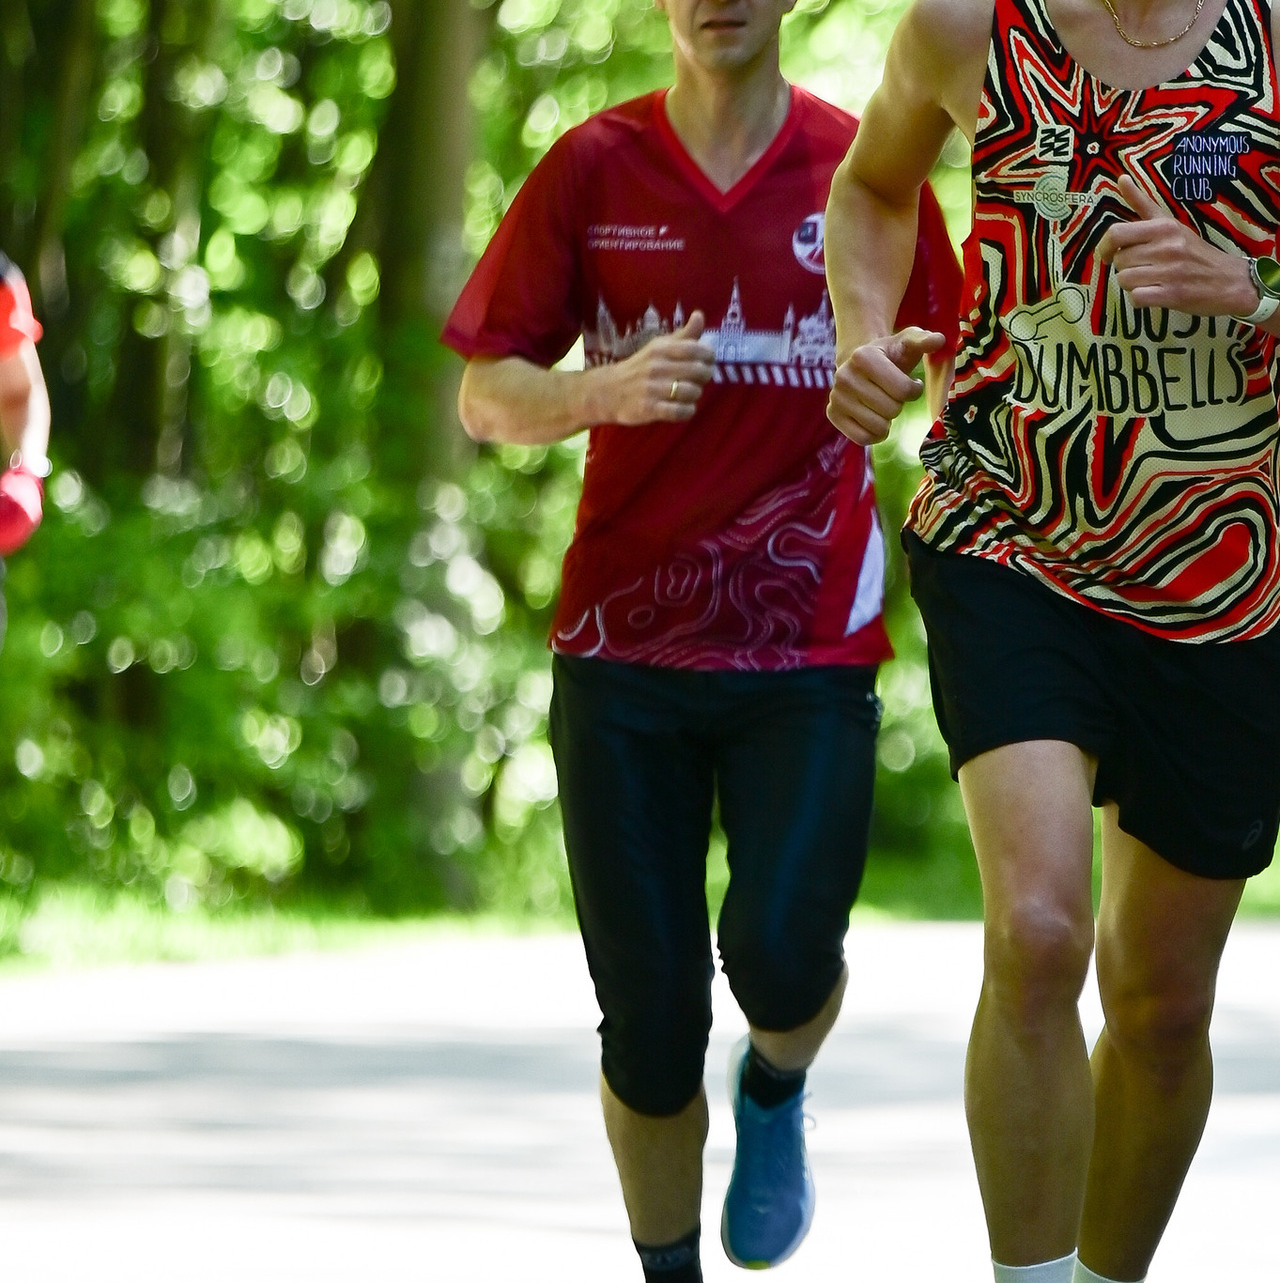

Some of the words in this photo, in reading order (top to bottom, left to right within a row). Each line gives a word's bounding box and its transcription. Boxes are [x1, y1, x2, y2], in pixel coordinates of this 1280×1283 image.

[1174, 135, 1250, 154] ANONYMOUS
[1173, 154, 1237, 178] RUNNING
[1015, 191, 1094, 204] SYNCROSFERA
[1172, 177, 1213, 201] CLUB
[1012, 340, 1246, 414] DUMBBELLS
